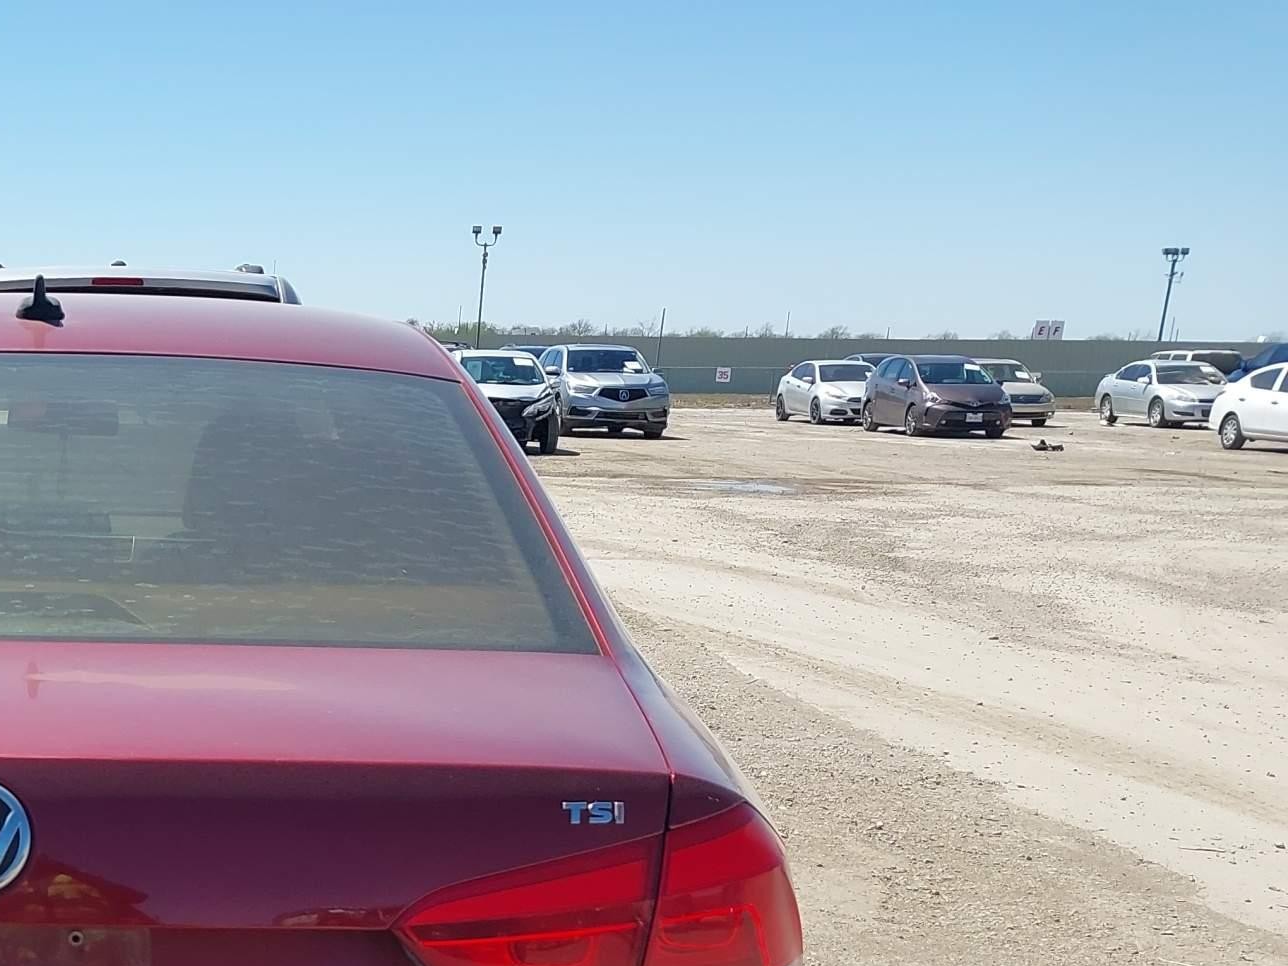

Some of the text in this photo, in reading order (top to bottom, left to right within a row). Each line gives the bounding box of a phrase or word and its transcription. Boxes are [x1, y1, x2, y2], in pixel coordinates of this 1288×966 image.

[1037, 325, 1046, 336] E
[1052, 325, 1061, 337] F
[717, 370, 729, 380] 35
[562, 801, 625, 825] TSI
